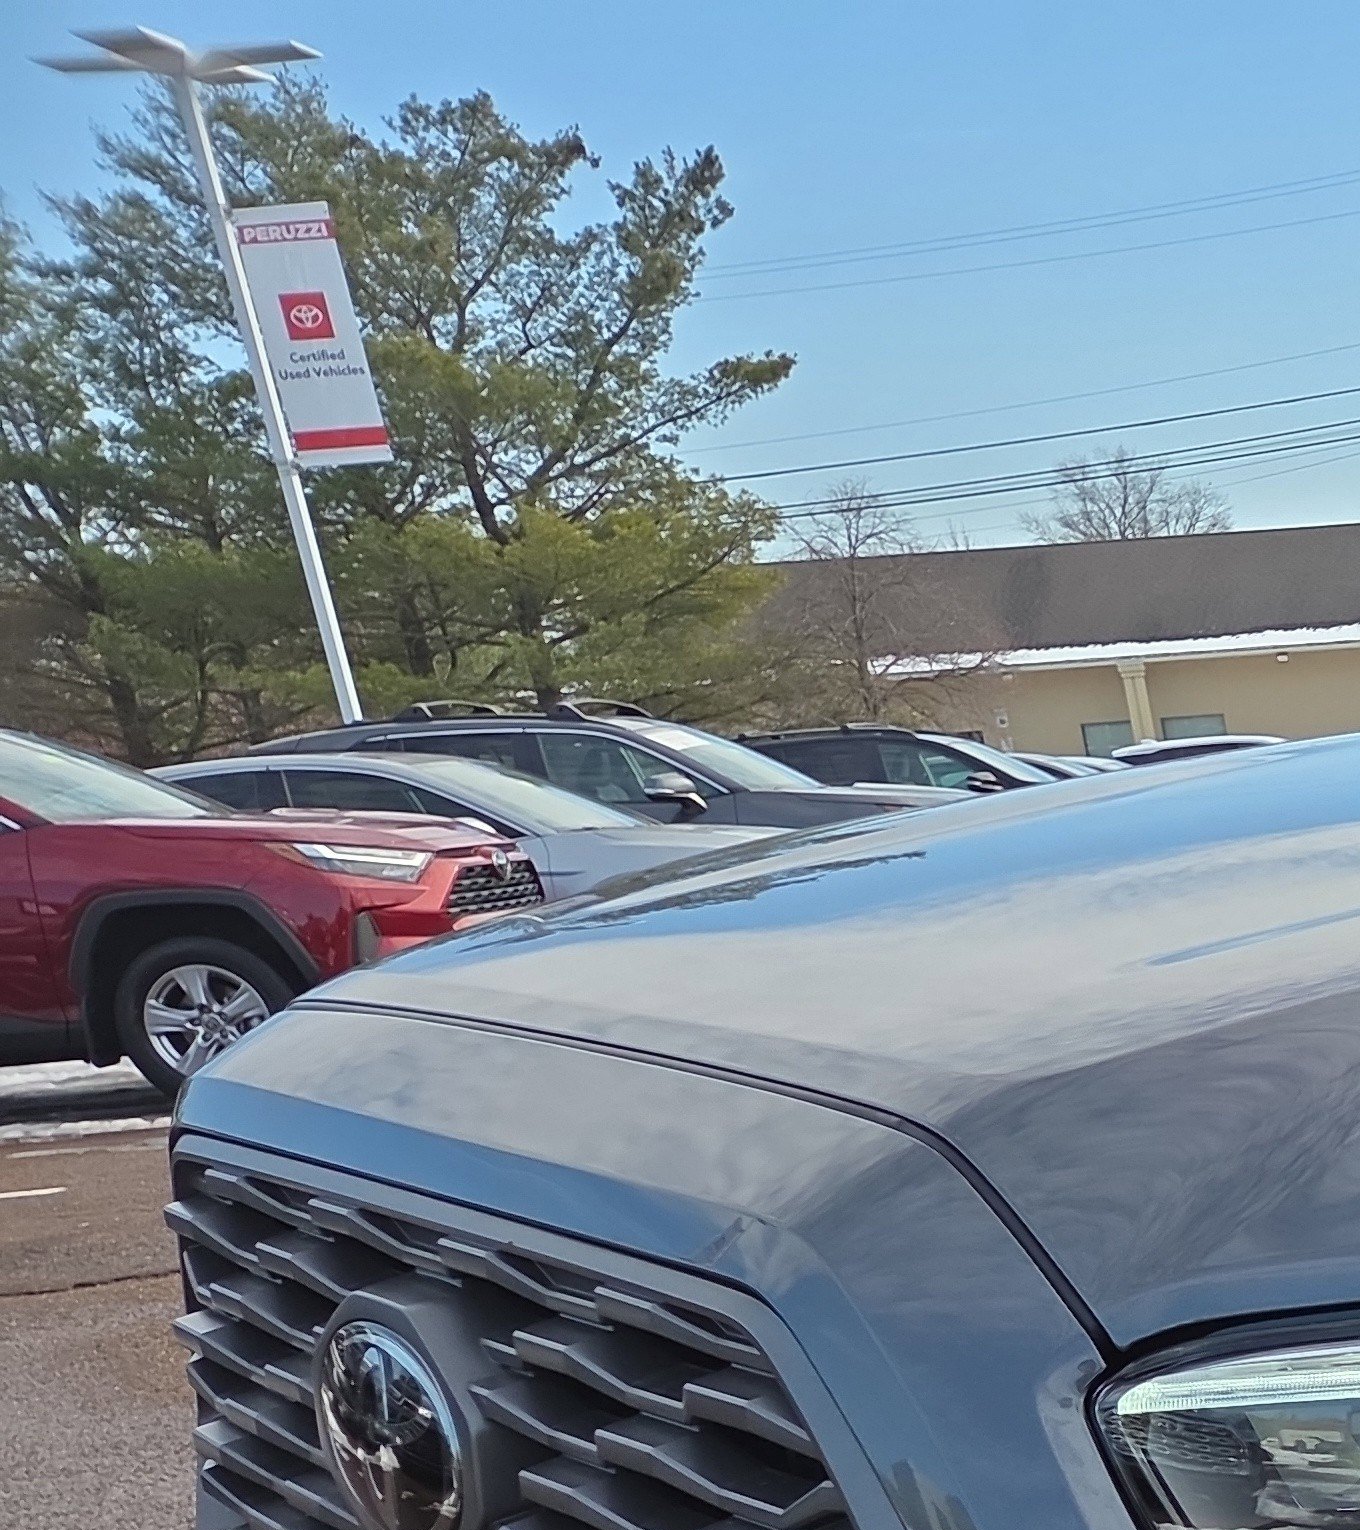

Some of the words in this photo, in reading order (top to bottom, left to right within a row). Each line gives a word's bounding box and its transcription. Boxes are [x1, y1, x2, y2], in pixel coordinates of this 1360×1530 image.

[243, 222, 328, 242] PERUZZI
[290, 348, 345, 363] Certified
[279, 367, 310, 380] Used
[313, 364, 365, 377] Vehicles
